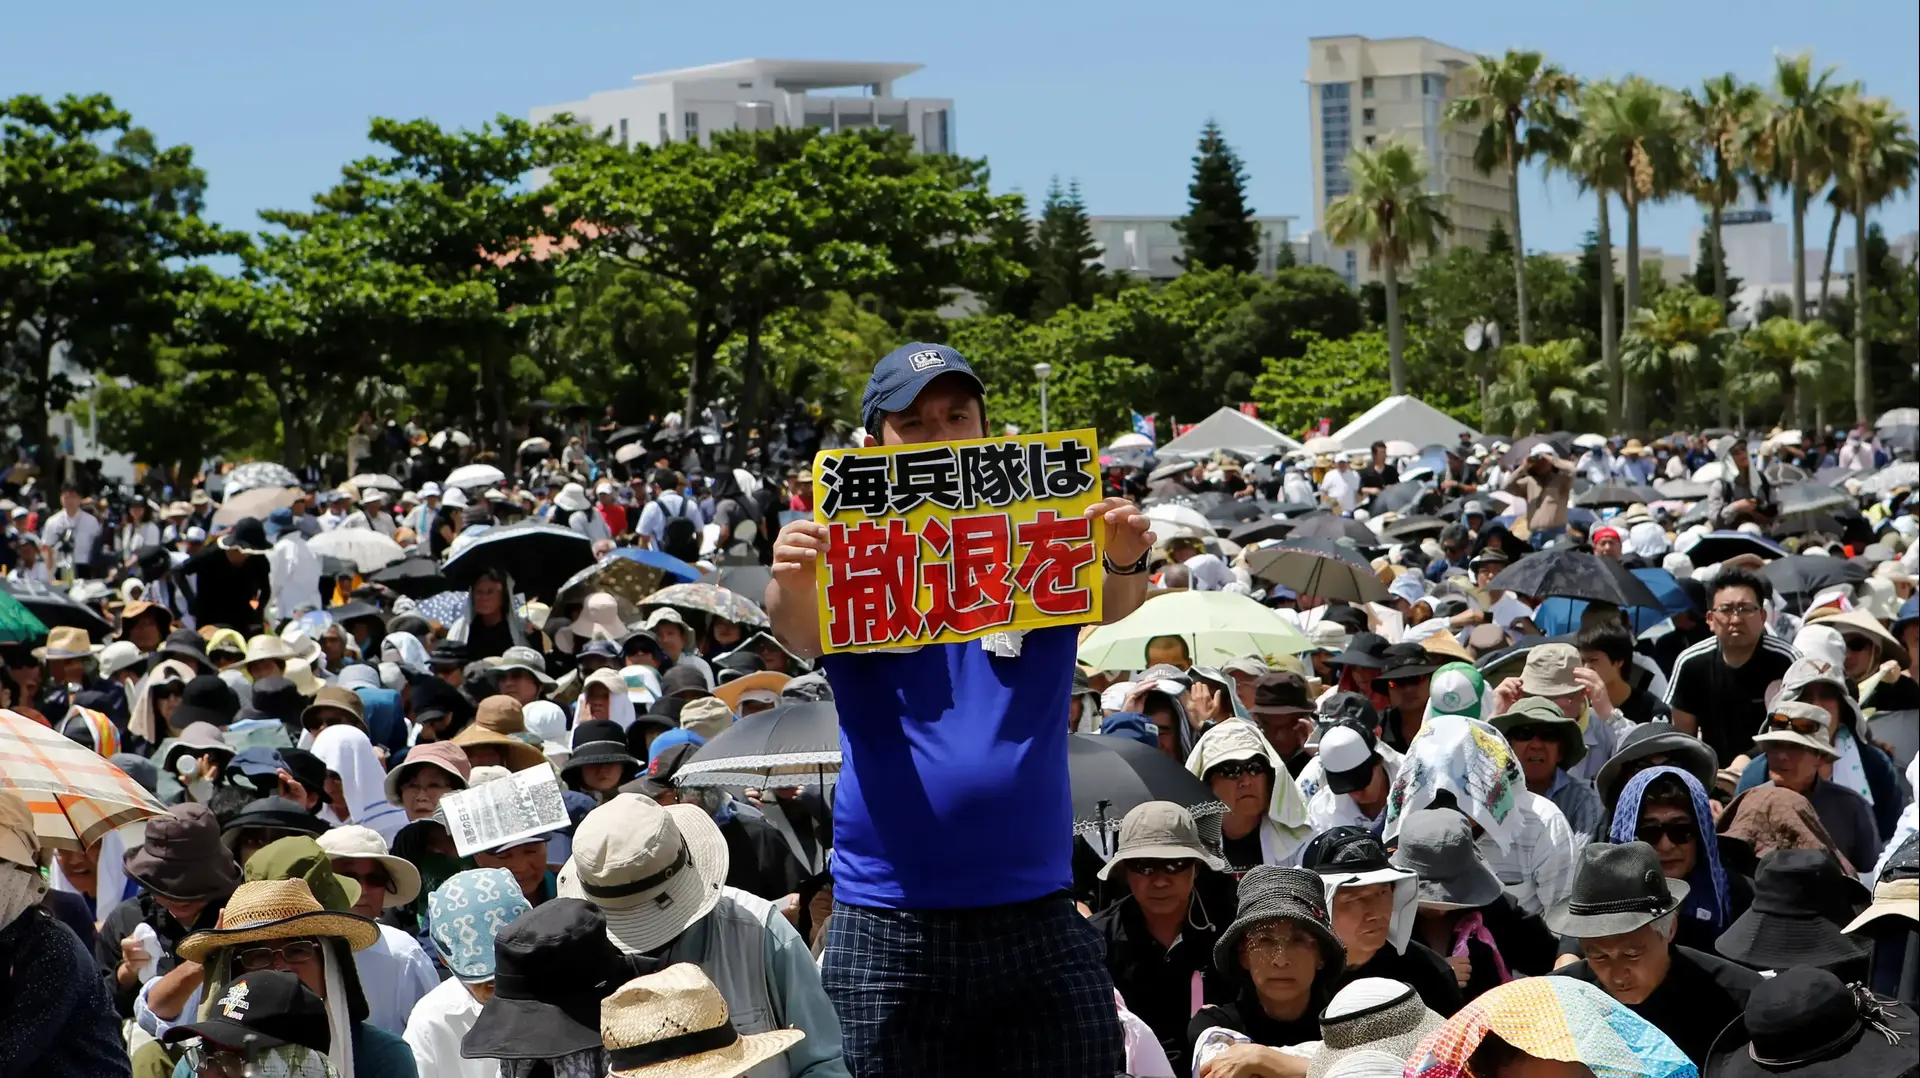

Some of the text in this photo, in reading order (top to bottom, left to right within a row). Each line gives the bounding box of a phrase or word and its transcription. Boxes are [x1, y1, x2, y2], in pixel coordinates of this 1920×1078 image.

[914, 352, 937, 363] GT
[821, 440, 1095, 518] 海兵隊は
[825, 510, 1095, 647] 撤退を
